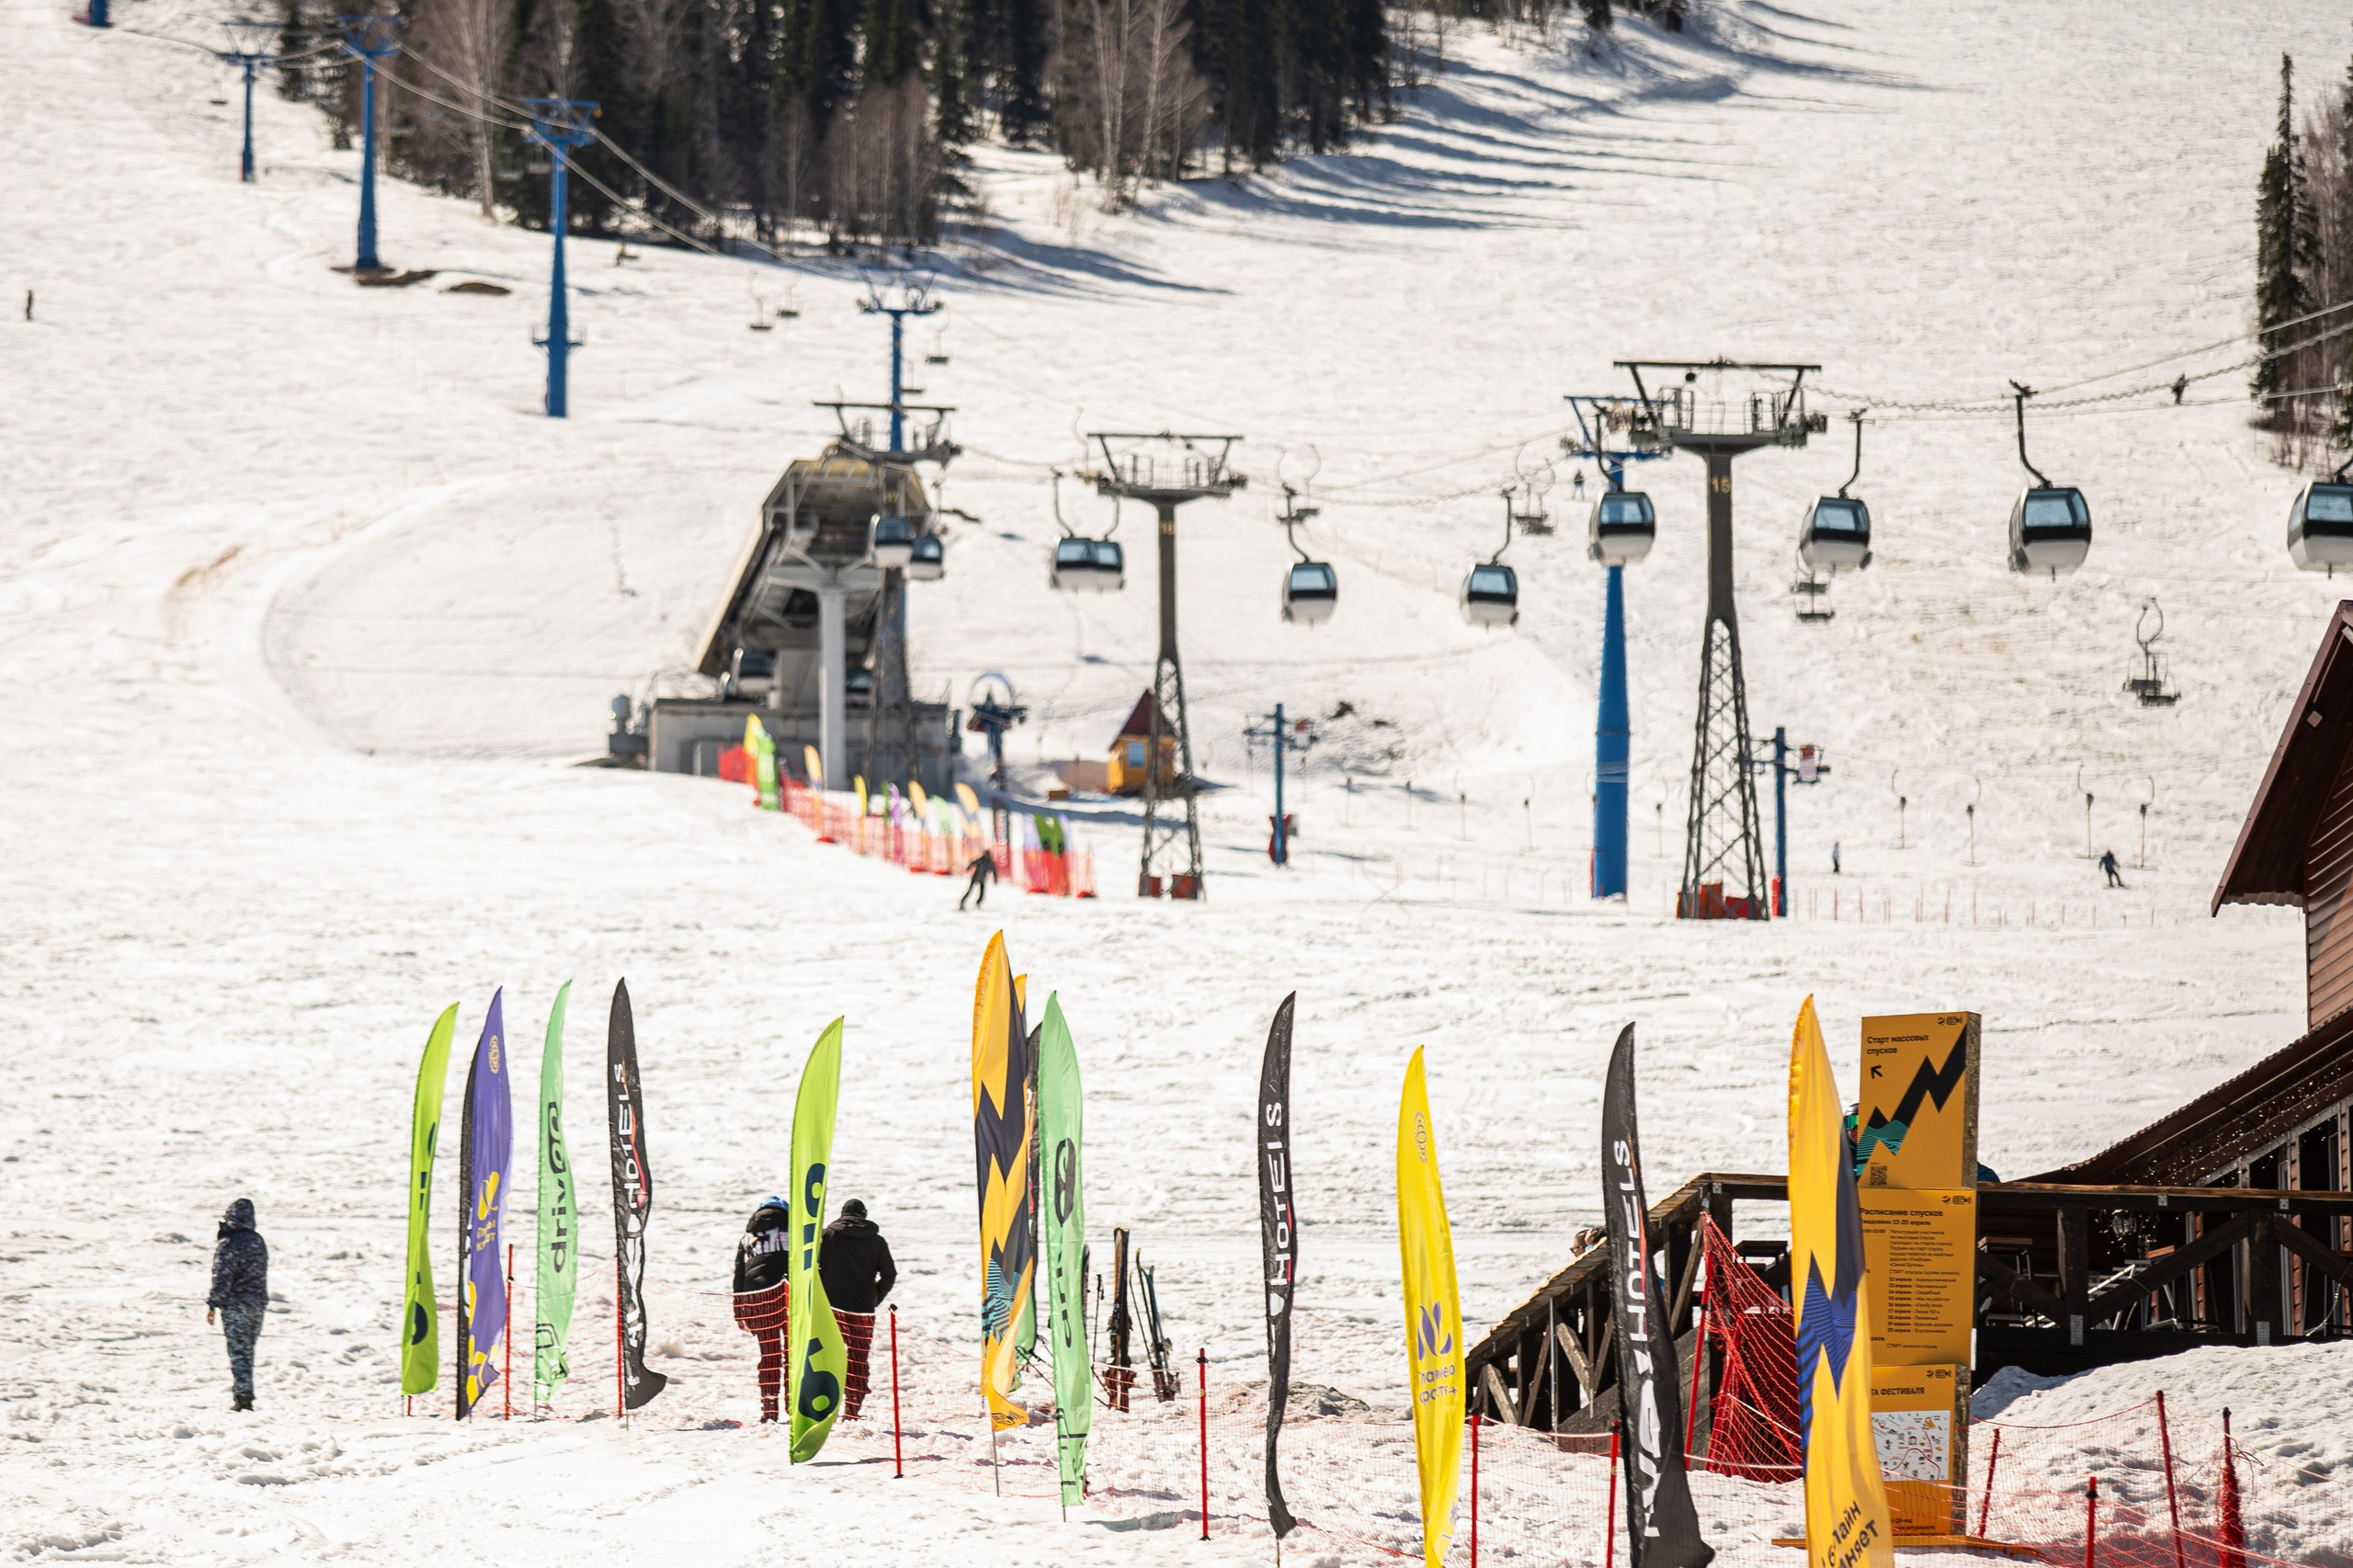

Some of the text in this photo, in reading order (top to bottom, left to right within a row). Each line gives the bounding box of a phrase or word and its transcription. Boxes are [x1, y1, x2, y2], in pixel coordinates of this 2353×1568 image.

[1711, 475, 1731, 494] 15
[1867, 1034, 1929, 1045] Старт массовых
[1866, 1047, 1898, 1056] спусков
[1859, 1208, 1943, 1218] Расписание спусков
[1613, 1139, 1649, 1343] HOTELS
[1880, 1387, 1925, 1396] ФЕСТИВАЛЯ
